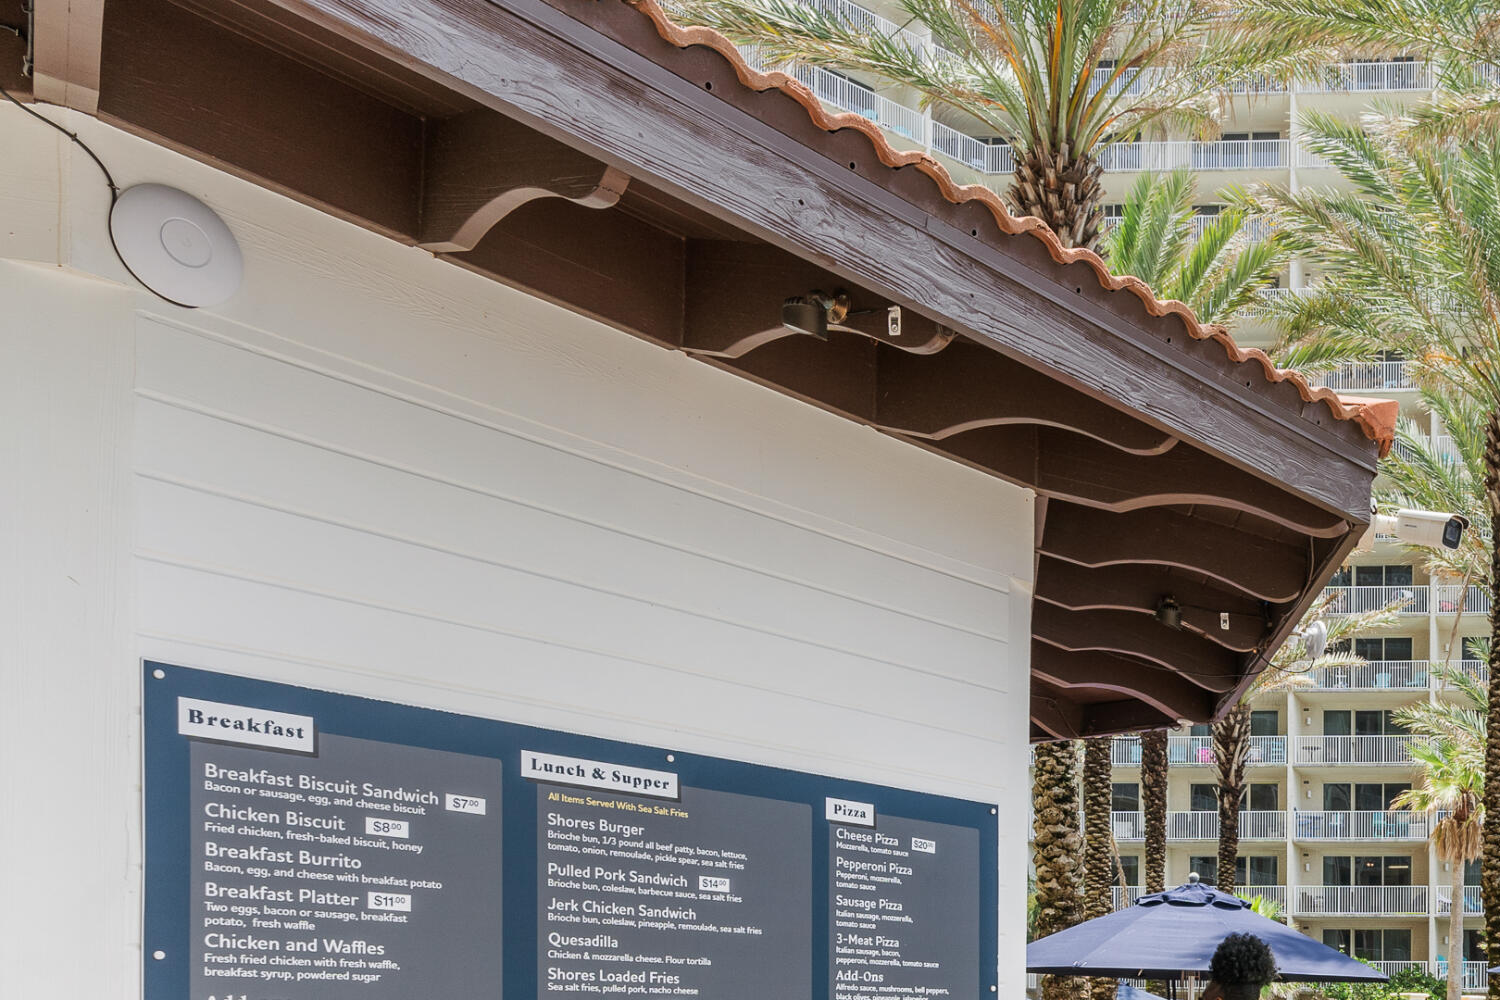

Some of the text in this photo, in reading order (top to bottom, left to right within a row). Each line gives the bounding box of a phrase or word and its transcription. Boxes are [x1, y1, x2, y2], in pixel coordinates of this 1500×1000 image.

[188, 708, 304, 739] Breakfast
[204, 762, 439, 805] Breakfast Biscuit Sandwich
[531, 757, 670, 790] Lunch & Supper
[204, 779, 241, 794] Bacon
[242, 787, 257, 796] or
[333, 797, 353, 807] and
[354, 798, 391, 811] cheese
[392, 802, 426, 816] biscuit
[547, 791, 689, 819] All Items Served With Sea Salt Fries
[204, 802, 346, 831] Chicken Biscuit
[833, 803, 866, 819] Pizza
[547, 812, 645, 838] Shores Burger
[835, 827, 899, 846] Cheese Pizza
[204, 821, 235, 834] Fried
[285, 829, 351, 845] fresh-baked
[391, 840, 423, 855] honey
[205, 841, 362, 869] Breakfast Burrito
[835, 855, 913, 876] Pepperoni Pizza
[273, 867, 294, 878] and
[295, 868, 335, 881] cheese
[335, 871, 359, 883] with
[361, 873, 409, 887] breakfast
[409, 879, 443, 890] potato
[547, 862, 688, 888] Pulled Pork Sandwich
[204, 881, 360, 906] Breakfast Platter
[835, 894, 903, 911] Sausage Pizza
[203, 900, 228, 912] Two
[263, 904, 297, 916] bacon
[298, 909, 313, 917] or
[360, 911, 408, 923] breakfast
[547, 897, 697, 920] Jerk Chicken Sandwich
[251, 917, 282, 929] fresh
[283, 919, 316, 931] waffle
[203, 932, 385, 956] Chicken and Waffles
[547, 931, 618, 948] Quesadilla
[836, 932, 900, 948] 3-Meat Pizza
[203, 952, 238, 964] Fresh
[239, 953, 267, 965] fried
[268, 955, 312, 966] chicken
[313, 956, 337, 968] with
[338, 957, 367, 968] fresh
[203, 965, 259, 978] breakfast
[296, 969, 350, 981] powdered
[351, 973, 382, 984] sugar
[547, 966, 680, 985] Shores Loaded Fries
[835, 969, 884, 983] Add-Ons
